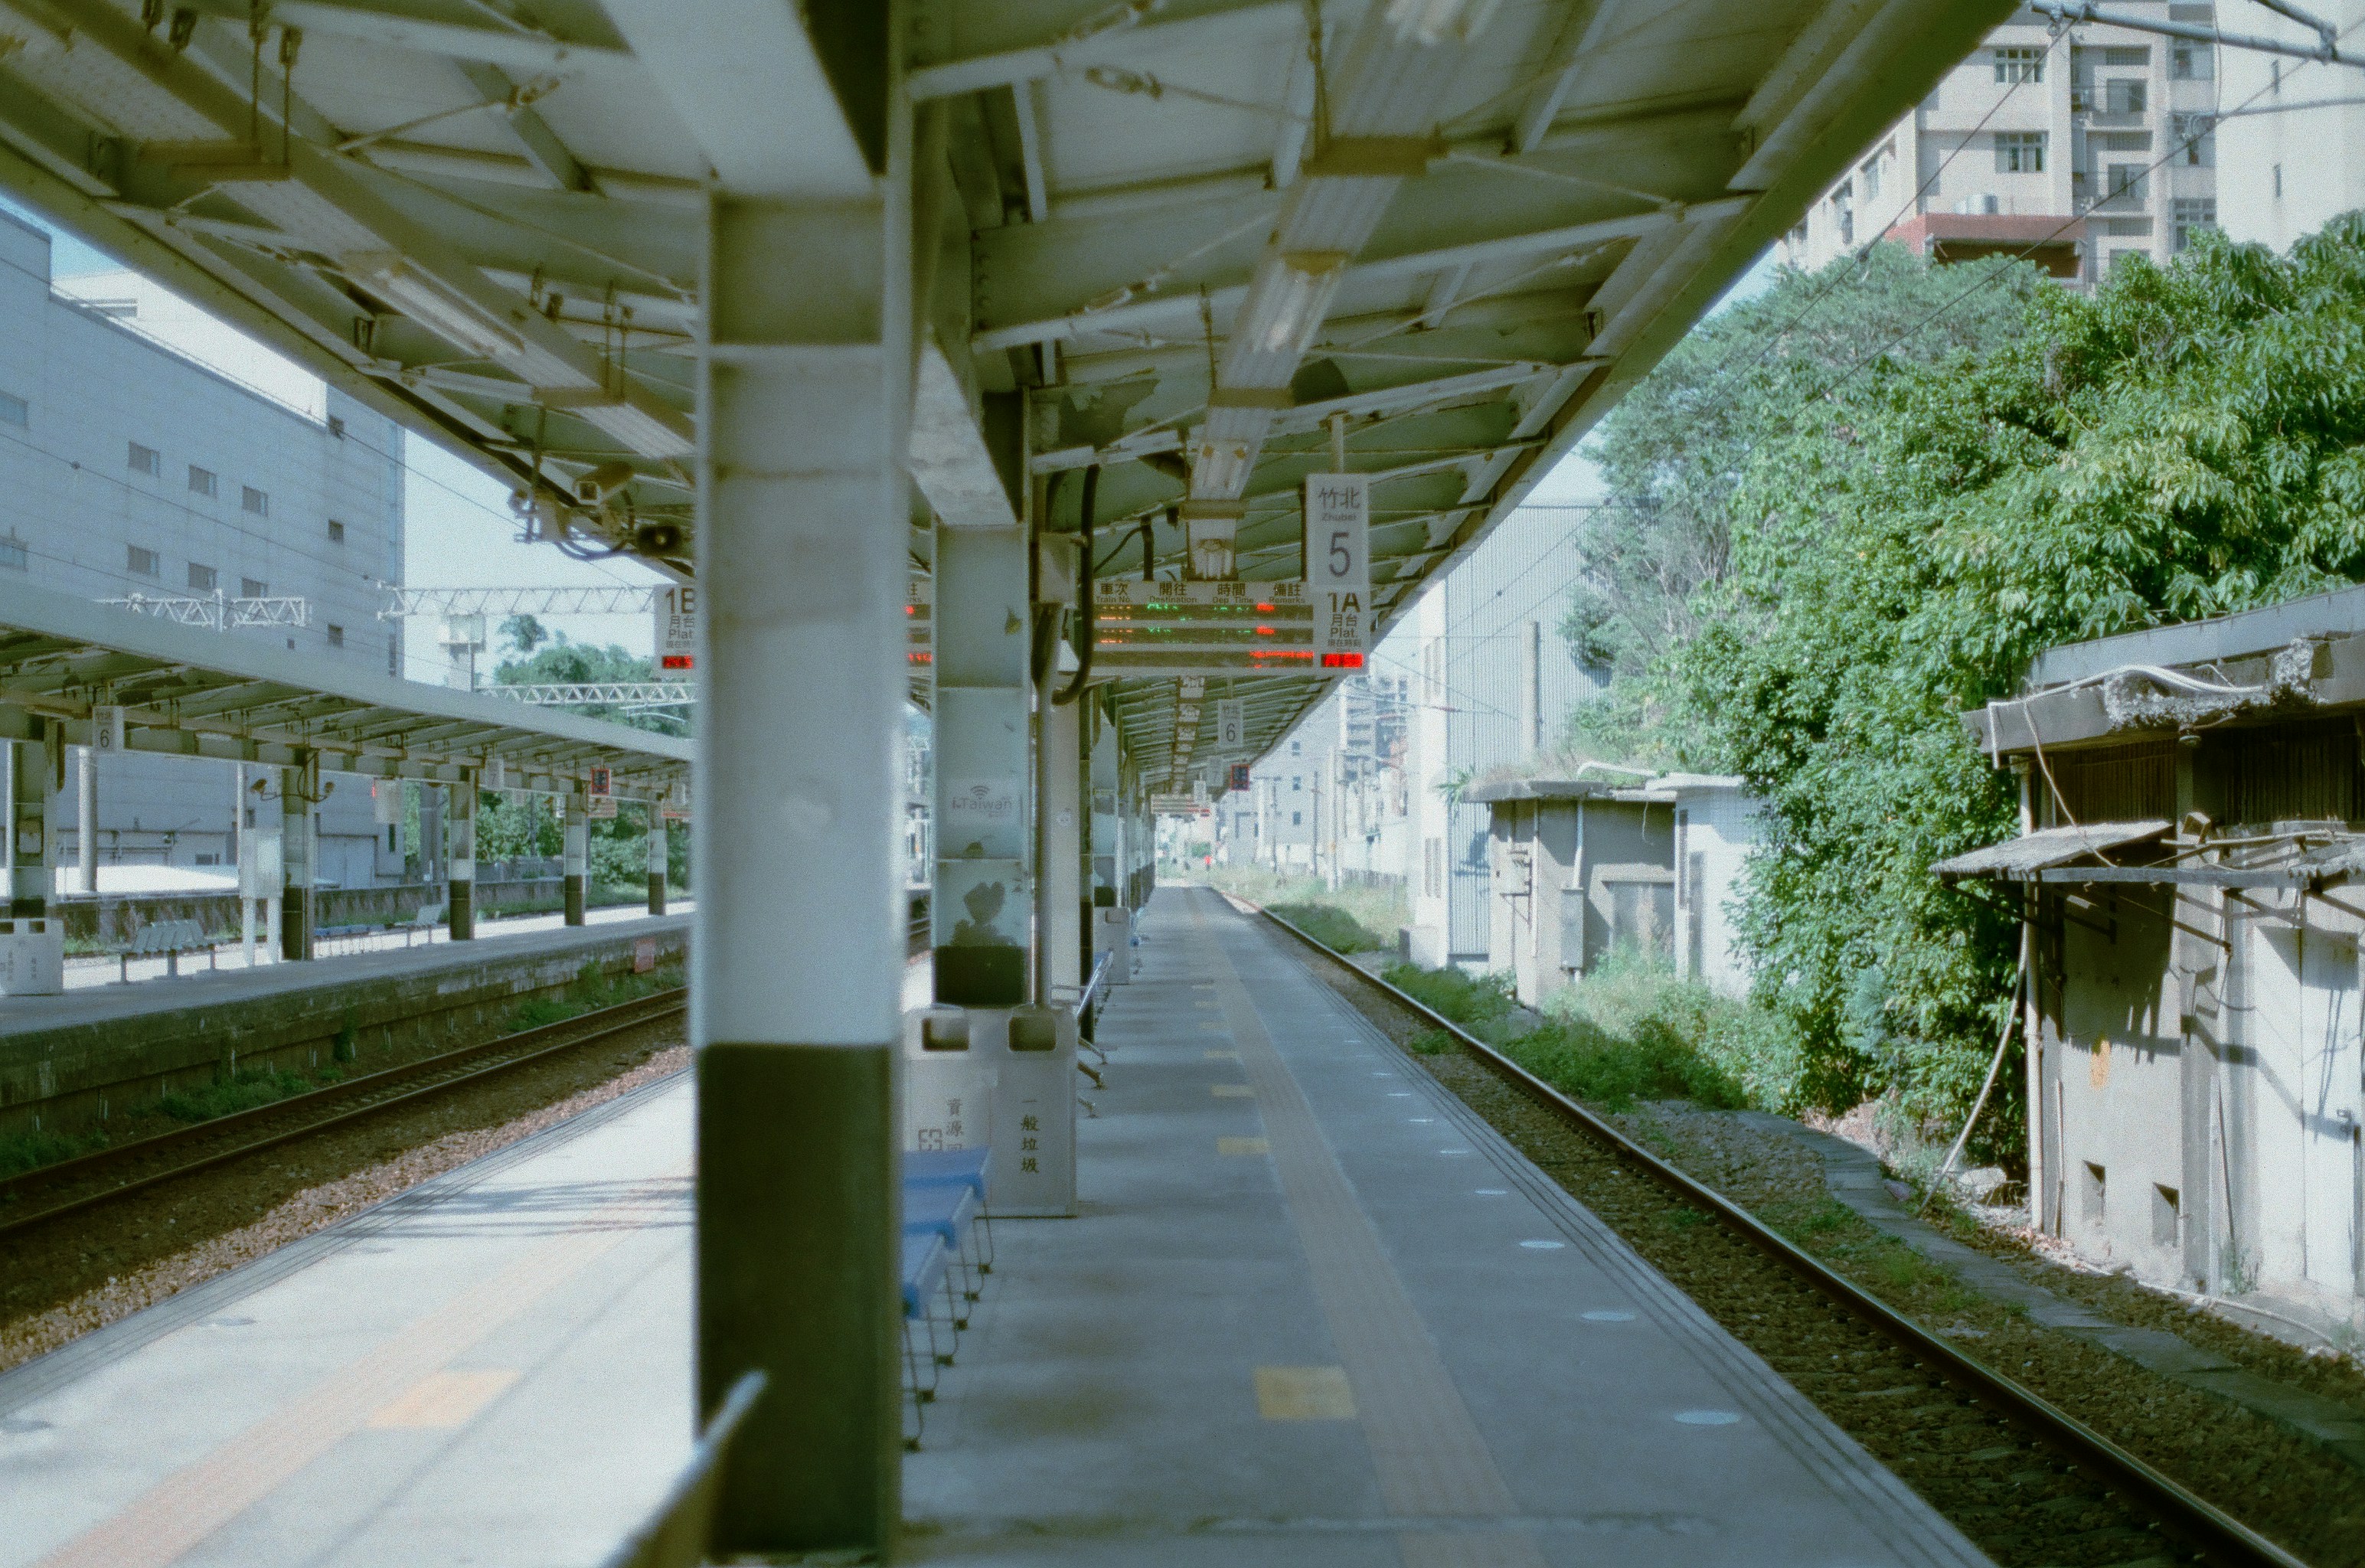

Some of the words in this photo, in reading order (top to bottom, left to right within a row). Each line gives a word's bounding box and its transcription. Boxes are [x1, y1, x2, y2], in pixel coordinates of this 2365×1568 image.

[1318, 486, 1360, 508] 竹北
[1322, 512, 1357, 521] Zhubei
[1329, 531, 1351, 577] 5
[1100, 583, 1129, 595] 車次
[1159, 583, 1187, 596] 開往
[1217, 583, 1246, 596] 時間
[1273, 583, 1302, 596] 備註
[1328, 592, 1361, 612] 1A
[1331, 613, 1358, 627] 月台
[1330, 627, 1358, 639] Plat.
[100, 729, 109, 748] 6
[1226, 723, 1236, 743] 6
[1021, 1099, 1039, 1174] 一般垃圾
